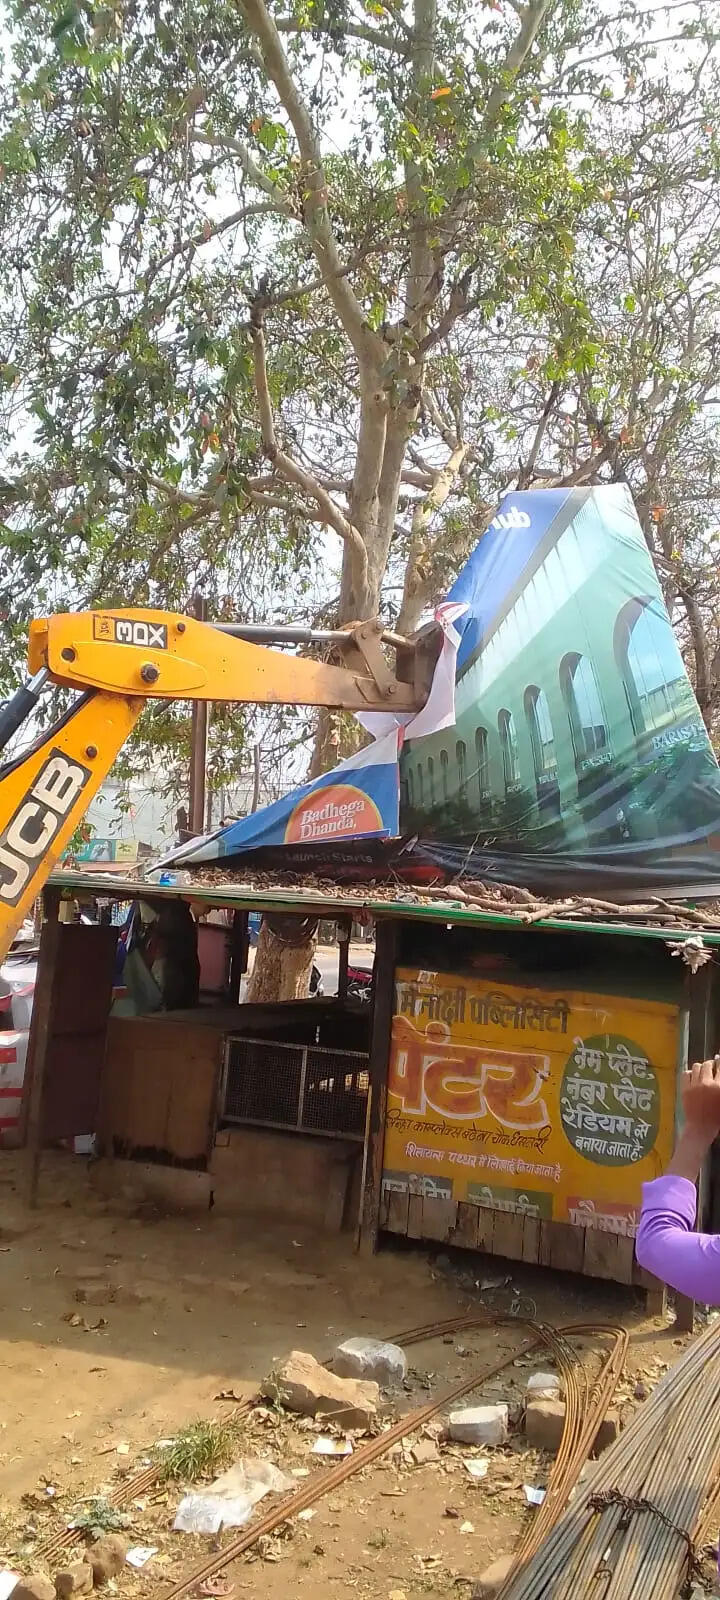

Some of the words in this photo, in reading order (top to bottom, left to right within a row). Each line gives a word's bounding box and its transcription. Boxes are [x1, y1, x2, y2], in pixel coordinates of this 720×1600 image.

[116, 621, 165, 648] 3DX
[652, 723, 706, 750] BARIST
[301, 799, 365, 825] Badhega
[0, 757, 86, 899] JCB
[300, 817, 357, 839] Dhanda,
[573, 1036, 604, 1073] नेम
[566, 1072, 610, 1110] नंबर
[610, 1078, 655, 1112] प्लेट
[561, 1096, 634, 1138] रेडियम
[633, 1117, 652, 1139] से
[575, 1135, 605, 1154] बनाया
[606, 1141, 630, 1158] जाता
